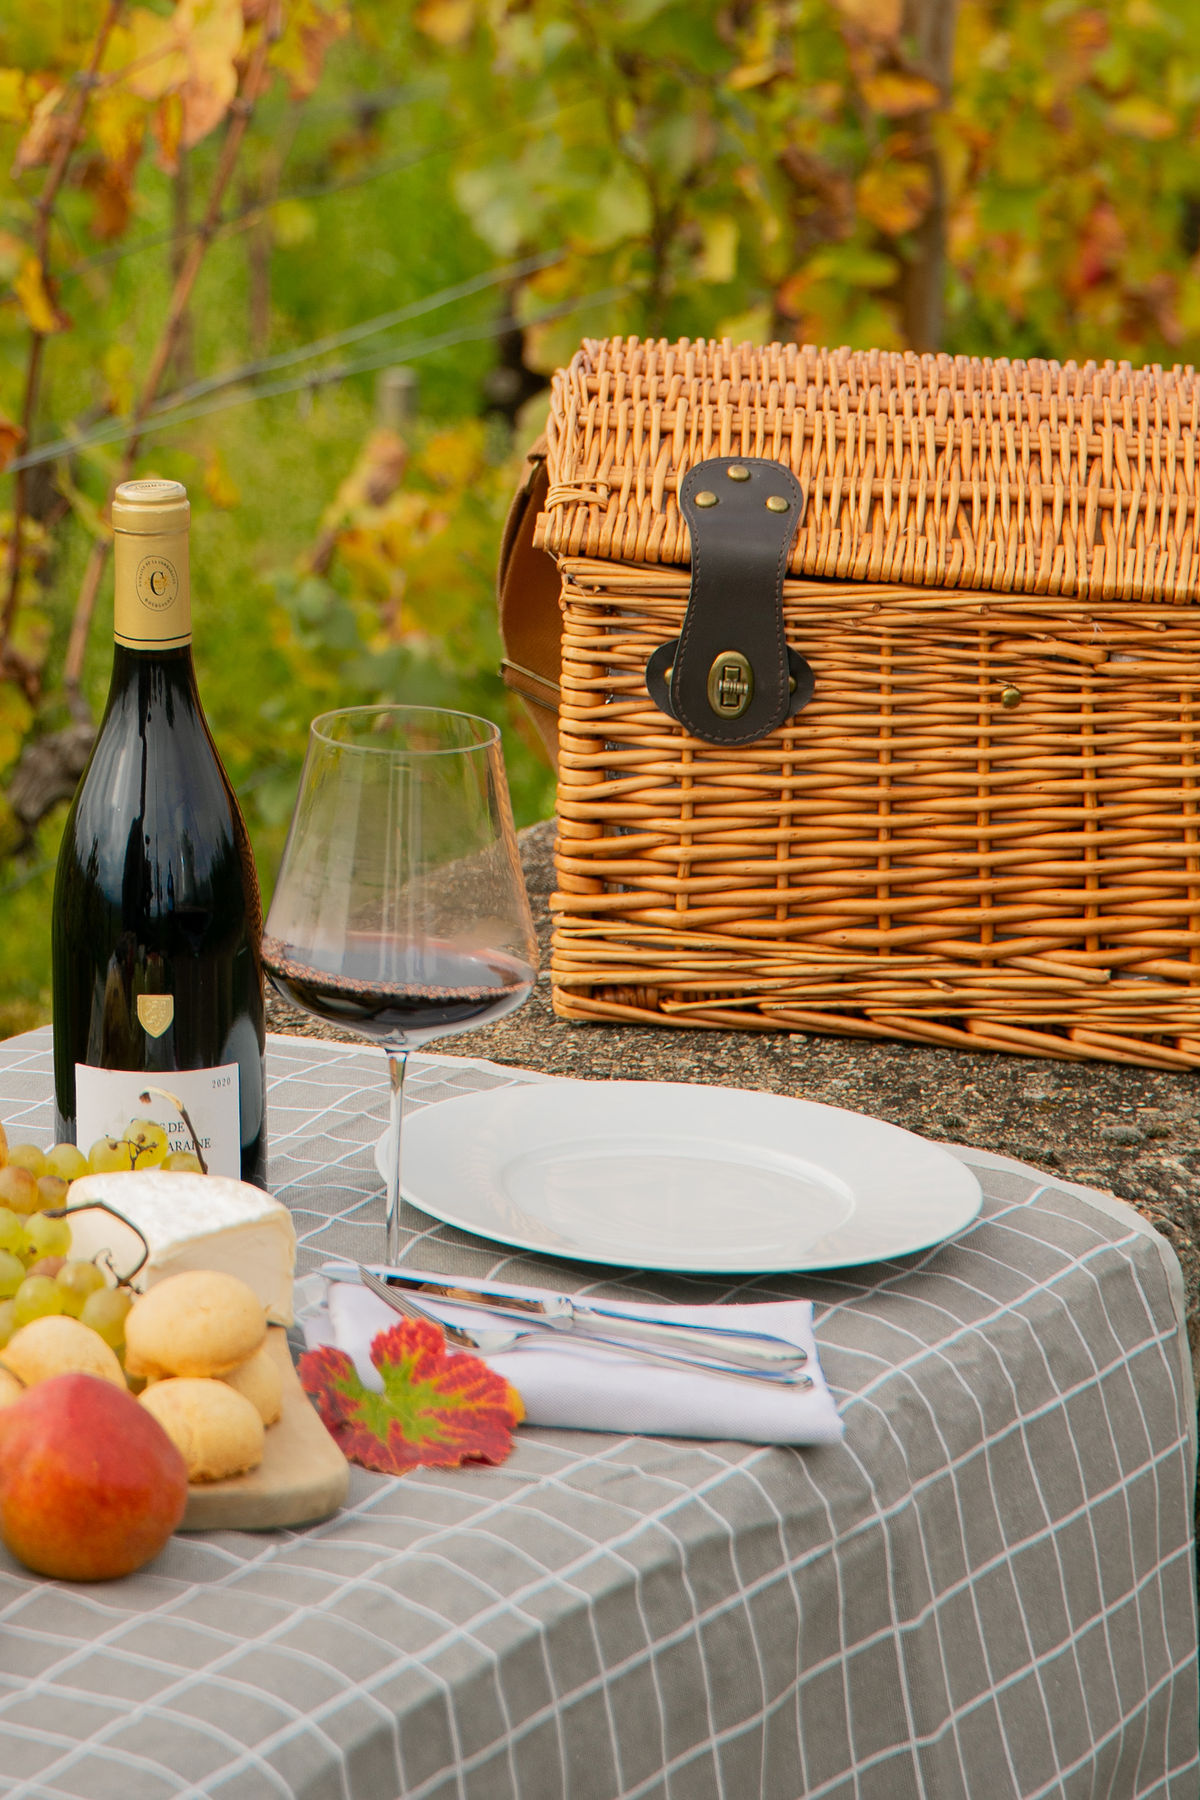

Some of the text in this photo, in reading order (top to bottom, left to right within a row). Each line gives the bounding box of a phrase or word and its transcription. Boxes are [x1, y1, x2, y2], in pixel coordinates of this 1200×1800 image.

[150, 571, 166, 597] C
[211, 1077, 231, 1089] 2020
[168, 1121, 185, 1133] DE
[168, 1137, 211, 1152] ARAINE
